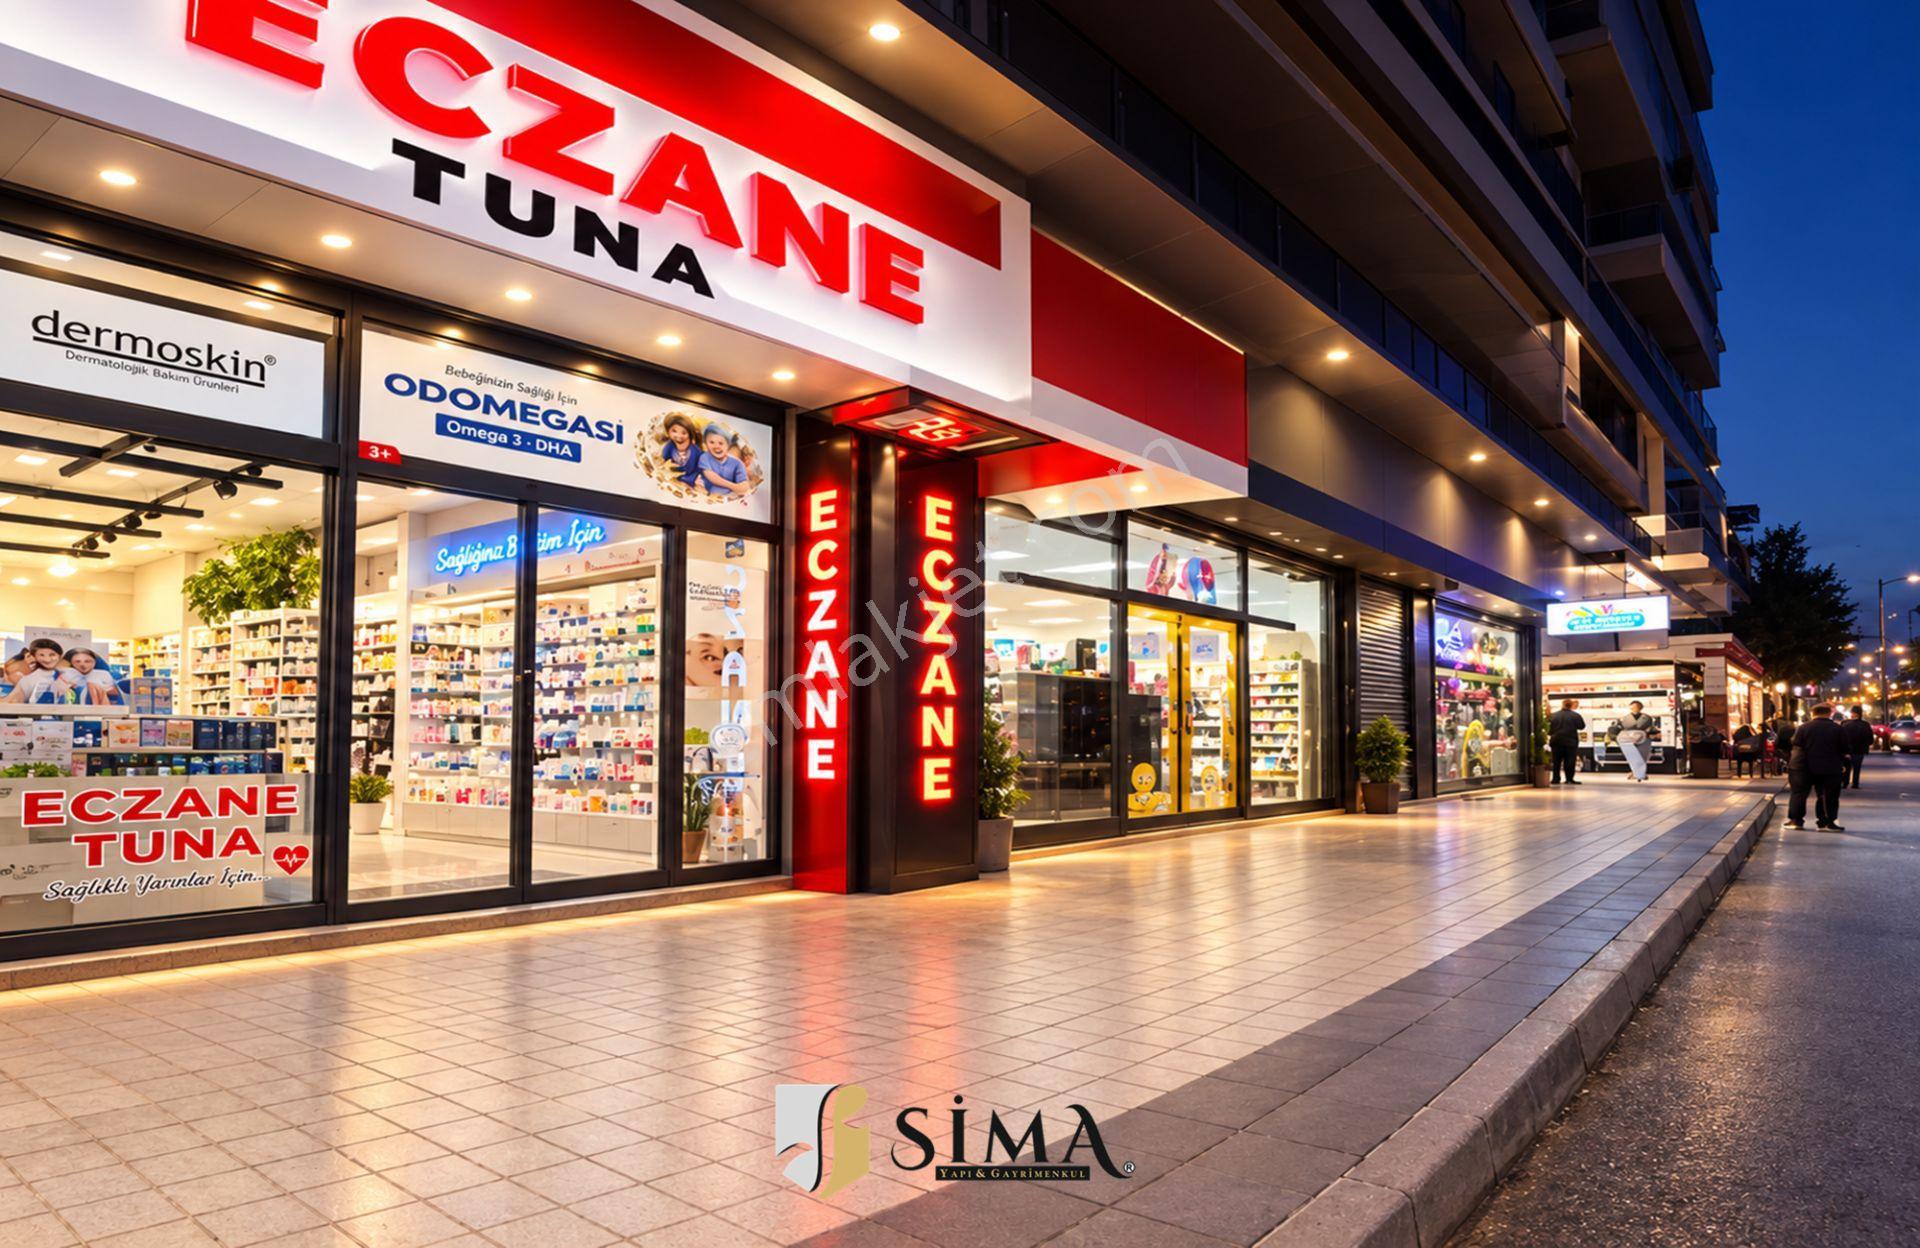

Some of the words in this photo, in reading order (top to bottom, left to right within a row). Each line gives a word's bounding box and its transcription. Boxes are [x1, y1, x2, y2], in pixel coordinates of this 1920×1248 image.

[186, 0, 923, 324] ECZANE
[392, 138, 714, 299] TUNA
[368, 445, 392, 459] 3+
[446, 420, 508, 444] Omega
[512, 433, 522, 446] 3
[535, 438, 573, 458] DHA
[804, 489, 840, 780] ECZANE
[920, 495, 957, 801] ECZANE
[22, 785, 298, 827] ECZANE
[71, 827, 263, 868] TUNA
[44, 875, 129, 903] Sağlıklı
[135, 870, 215, 897] Yarınlar
